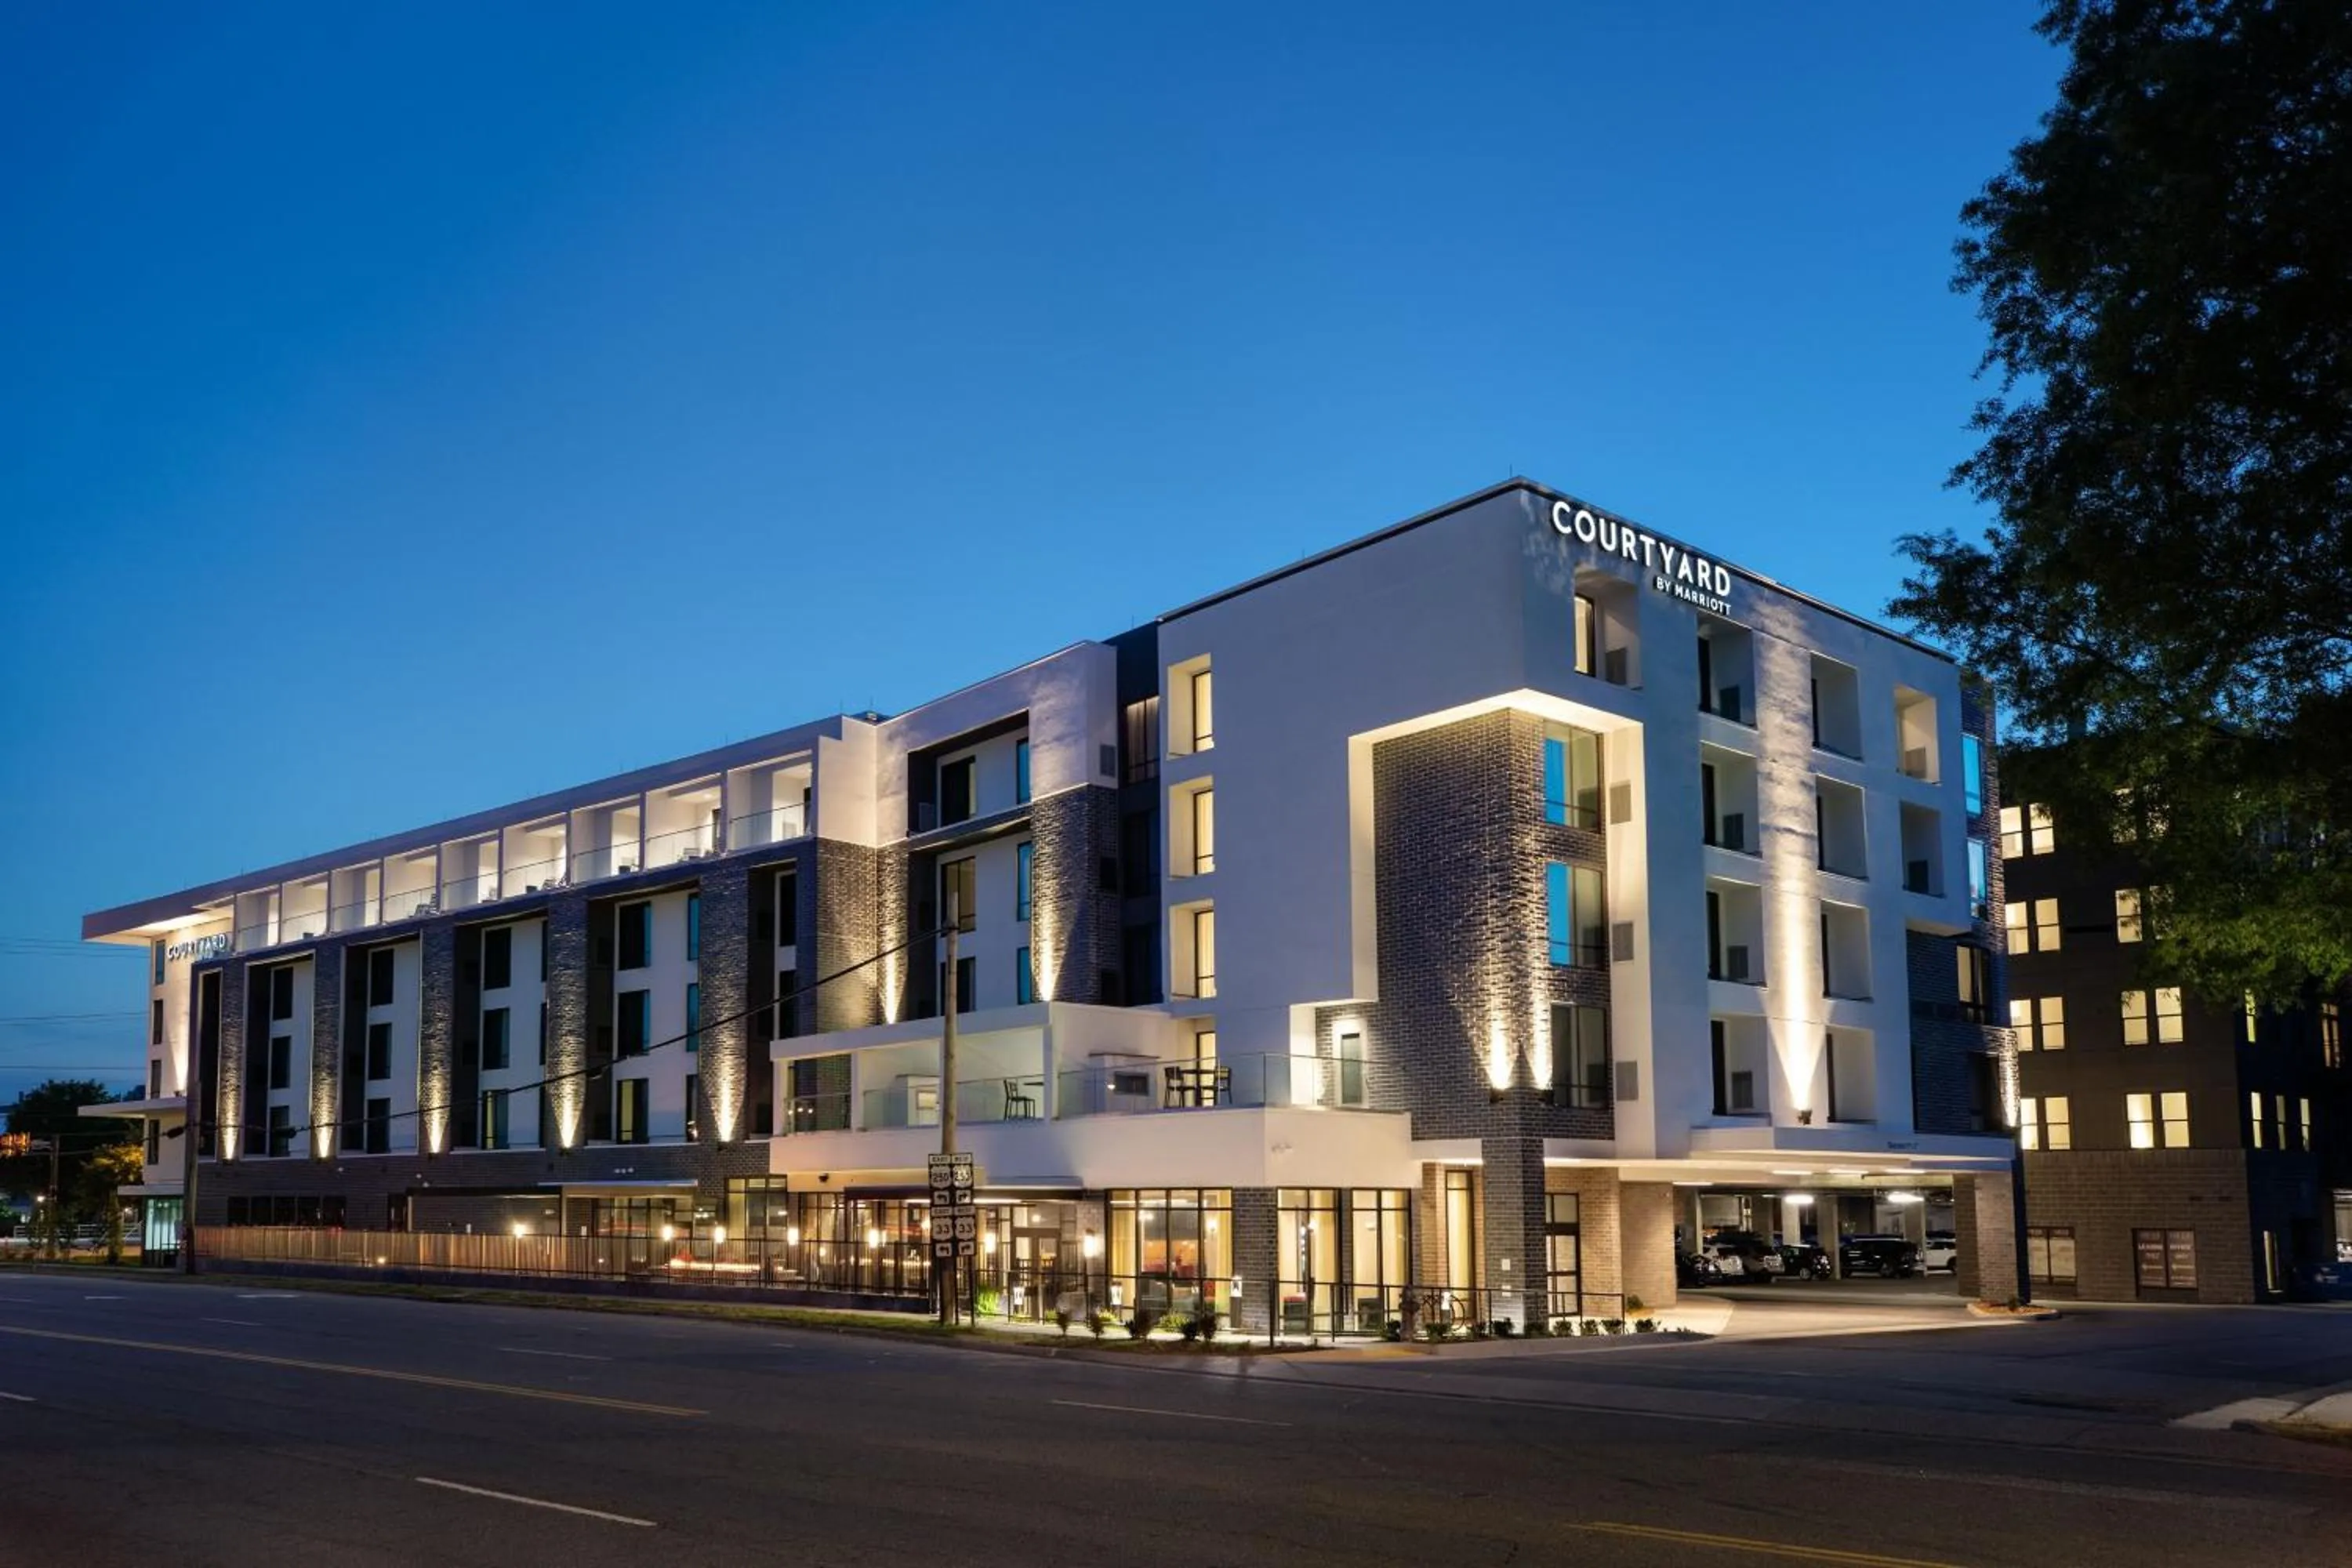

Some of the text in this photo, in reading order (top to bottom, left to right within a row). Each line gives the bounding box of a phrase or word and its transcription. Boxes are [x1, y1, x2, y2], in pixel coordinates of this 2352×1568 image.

[1552, 500, 1732, 597] COURTYARD
[1656, 576, 1732, 615] BY MARRIOTT
[935, 1224, 950, 1234] 33
[959, 1224, 972, 1233] 33
